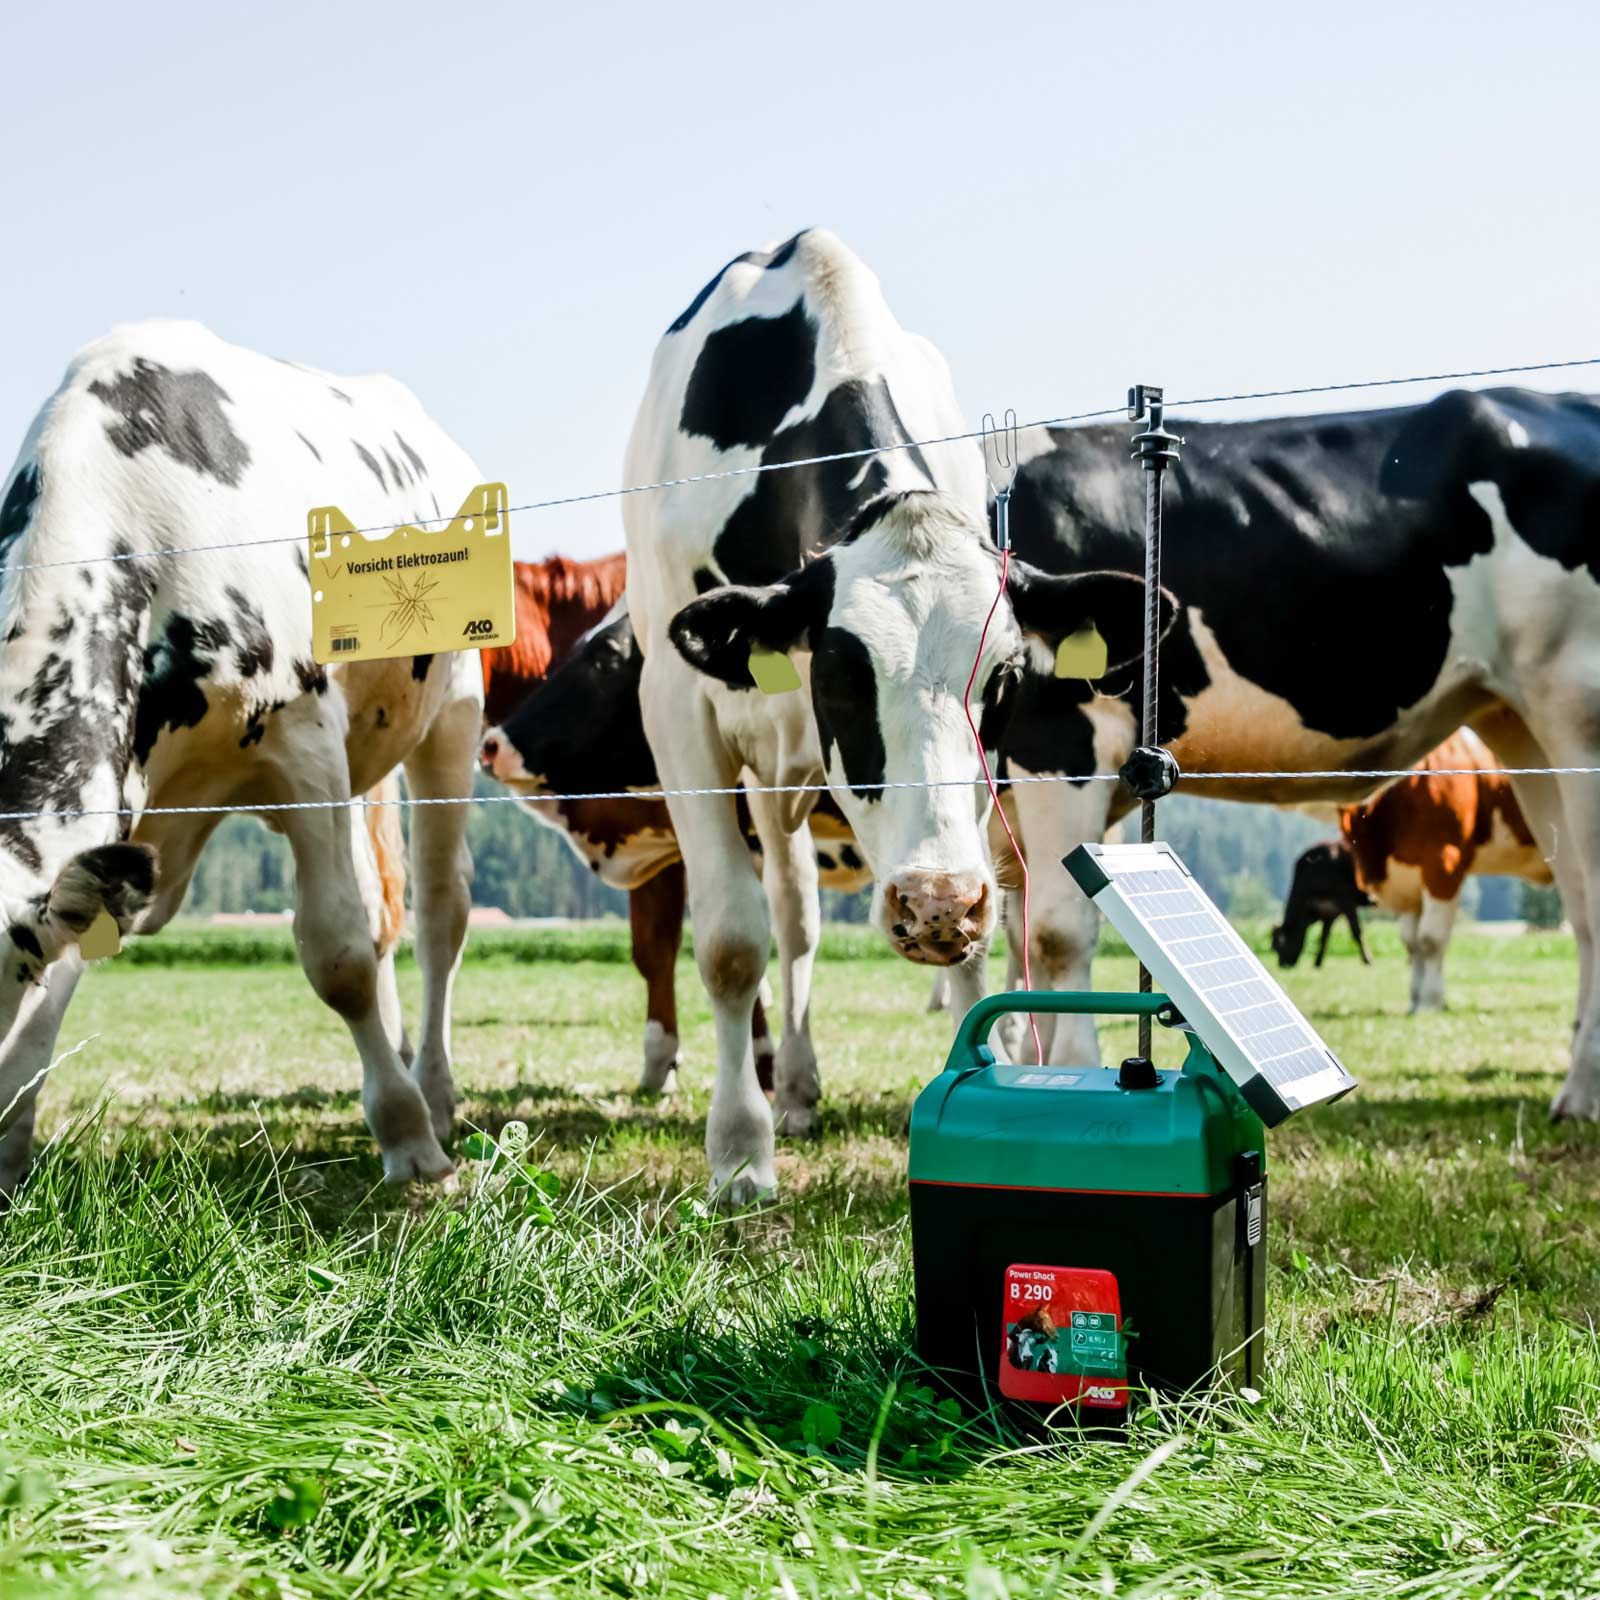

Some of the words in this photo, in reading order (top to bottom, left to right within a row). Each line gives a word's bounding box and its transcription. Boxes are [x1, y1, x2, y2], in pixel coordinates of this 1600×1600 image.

[347, 555, 393, 575] Vorsicht
[397, 548, 469, 569] Elektrozaun!
[462, 619, 493, 636] AKO
[1009, 1269, 1032, 1279] Power
[1033, 1271, 1056, 1281] Shock
[1010, 1283, 1020, 1299] B
[1024, 1284, 1052, 1301] 290
